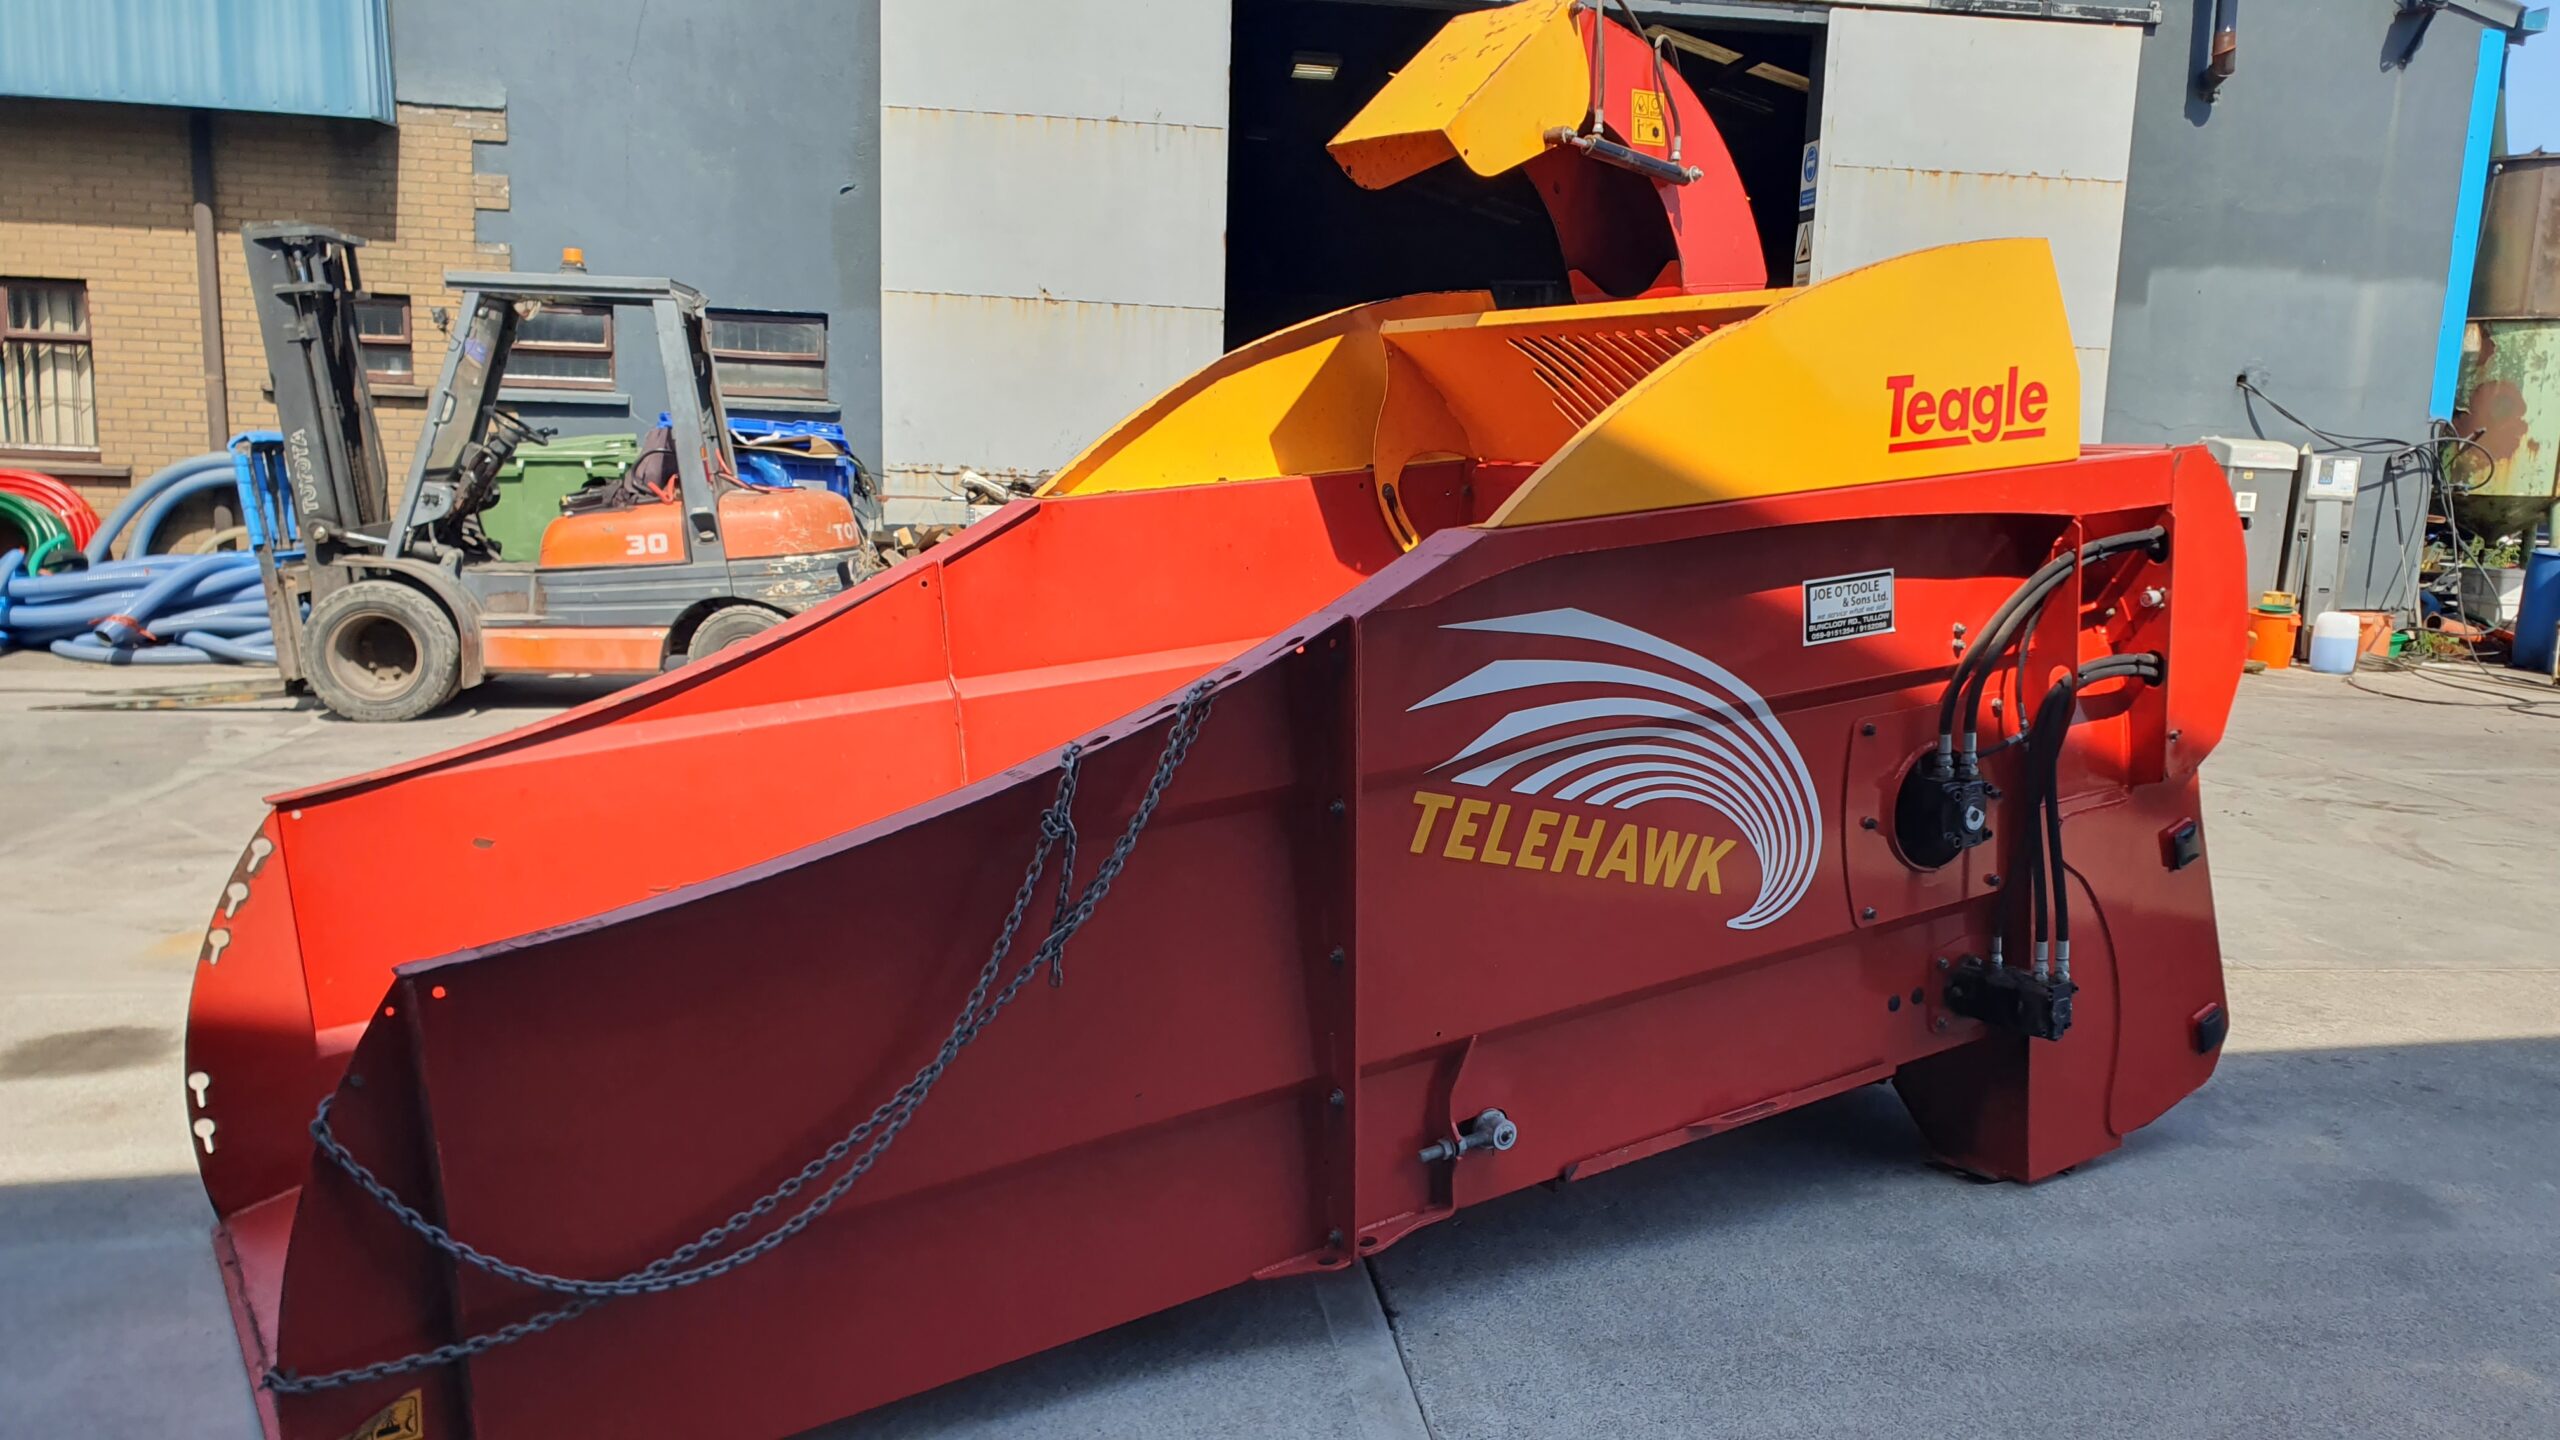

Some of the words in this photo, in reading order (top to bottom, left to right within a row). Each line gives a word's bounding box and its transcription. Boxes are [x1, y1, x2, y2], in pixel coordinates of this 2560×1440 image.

[1886, 366, 2048, 443] Teagle
[290, 428, 319, 514] TOYOTA
[625, 533, 669, 556] 30
[1812, 587, 1832, 601] JOE
[1834, 580, 1880, 598] O'TOOLE
[1842, 597, 1849, 607] &
[1851, 596, 1871, 606] Sons
[1872, 591, 1889, 602] Ltd.
[1862, 612, 1890, 623] TULLOW
[1410, 790, 1737, 895] TELEHAWK
